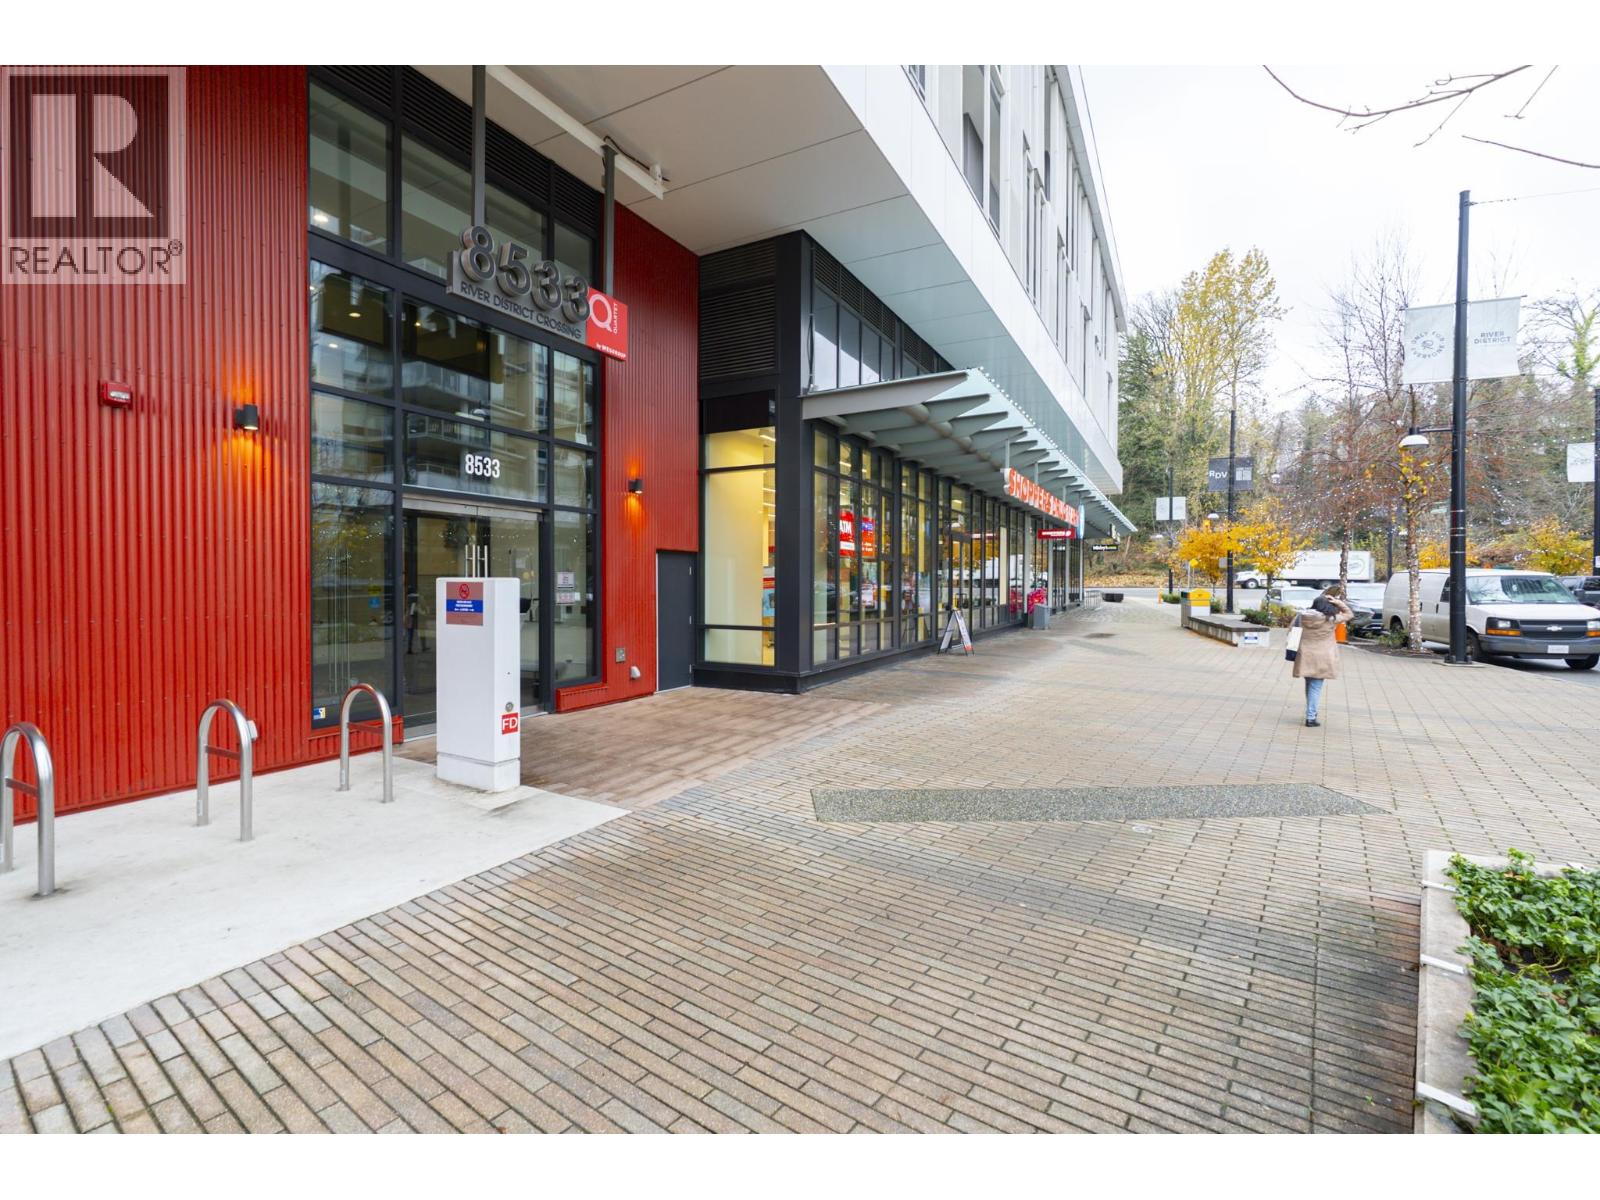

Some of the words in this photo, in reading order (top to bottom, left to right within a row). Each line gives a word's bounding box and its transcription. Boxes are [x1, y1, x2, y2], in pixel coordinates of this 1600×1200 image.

[461, 225, 590, 324] 8533
[460, 281, 491, 303] RIVER
[493, 295, 534, 320] DISTRICT
[536, 313, 582, 339] CROSSING
[1474, 336, 1511, 344] DISTRICT
[465, 453, 501, 479] 8533
[502, 717, 517, 731] FD
